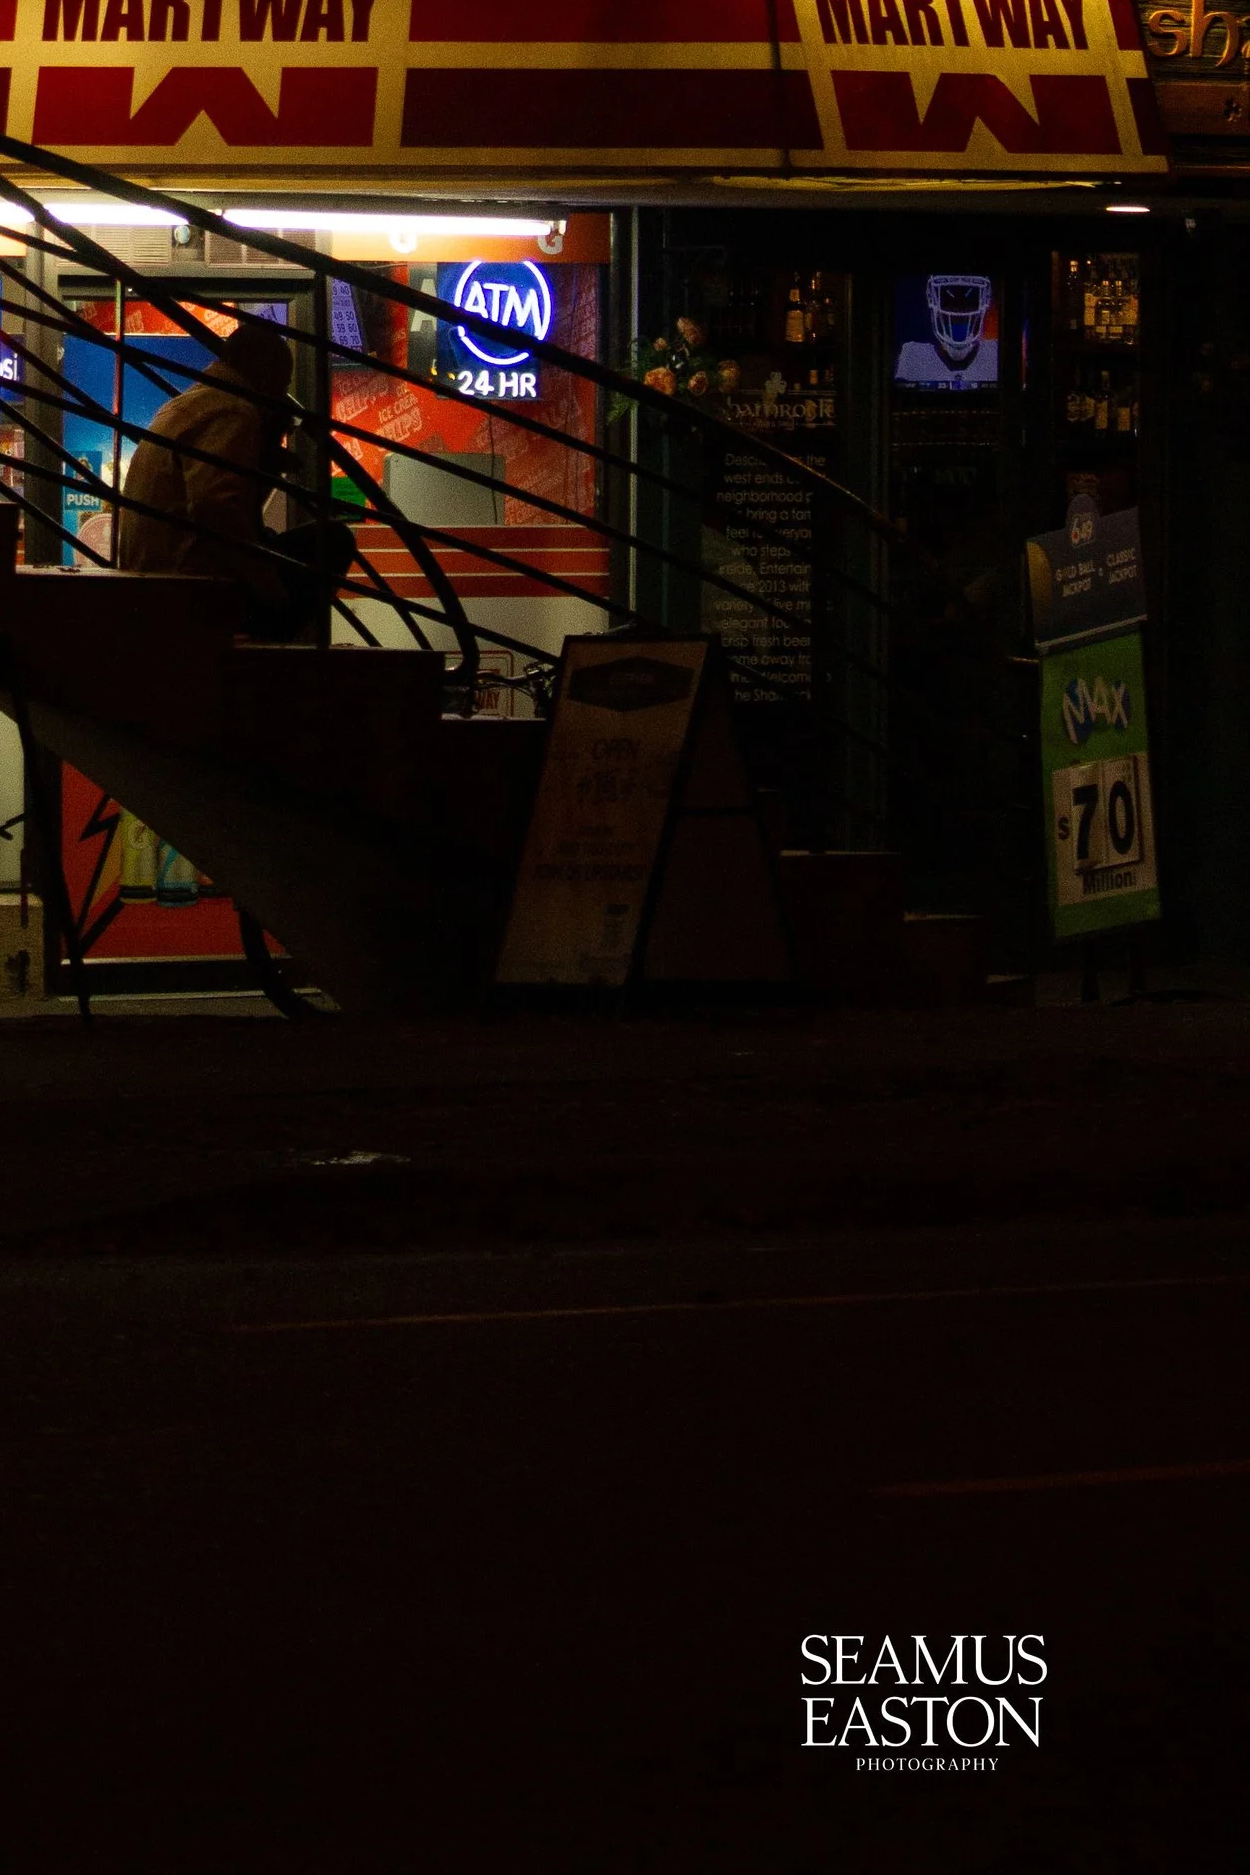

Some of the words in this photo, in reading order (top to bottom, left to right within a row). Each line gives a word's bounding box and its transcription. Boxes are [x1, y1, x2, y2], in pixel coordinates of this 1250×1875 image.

[463, 280, 545, 341] ATM
[457, 370, 495, 396] 24
[498, 372, 537, 398] HR
[66, 493, 100, 507] PUSH
[1062, 675, 1130, 745] MAX
